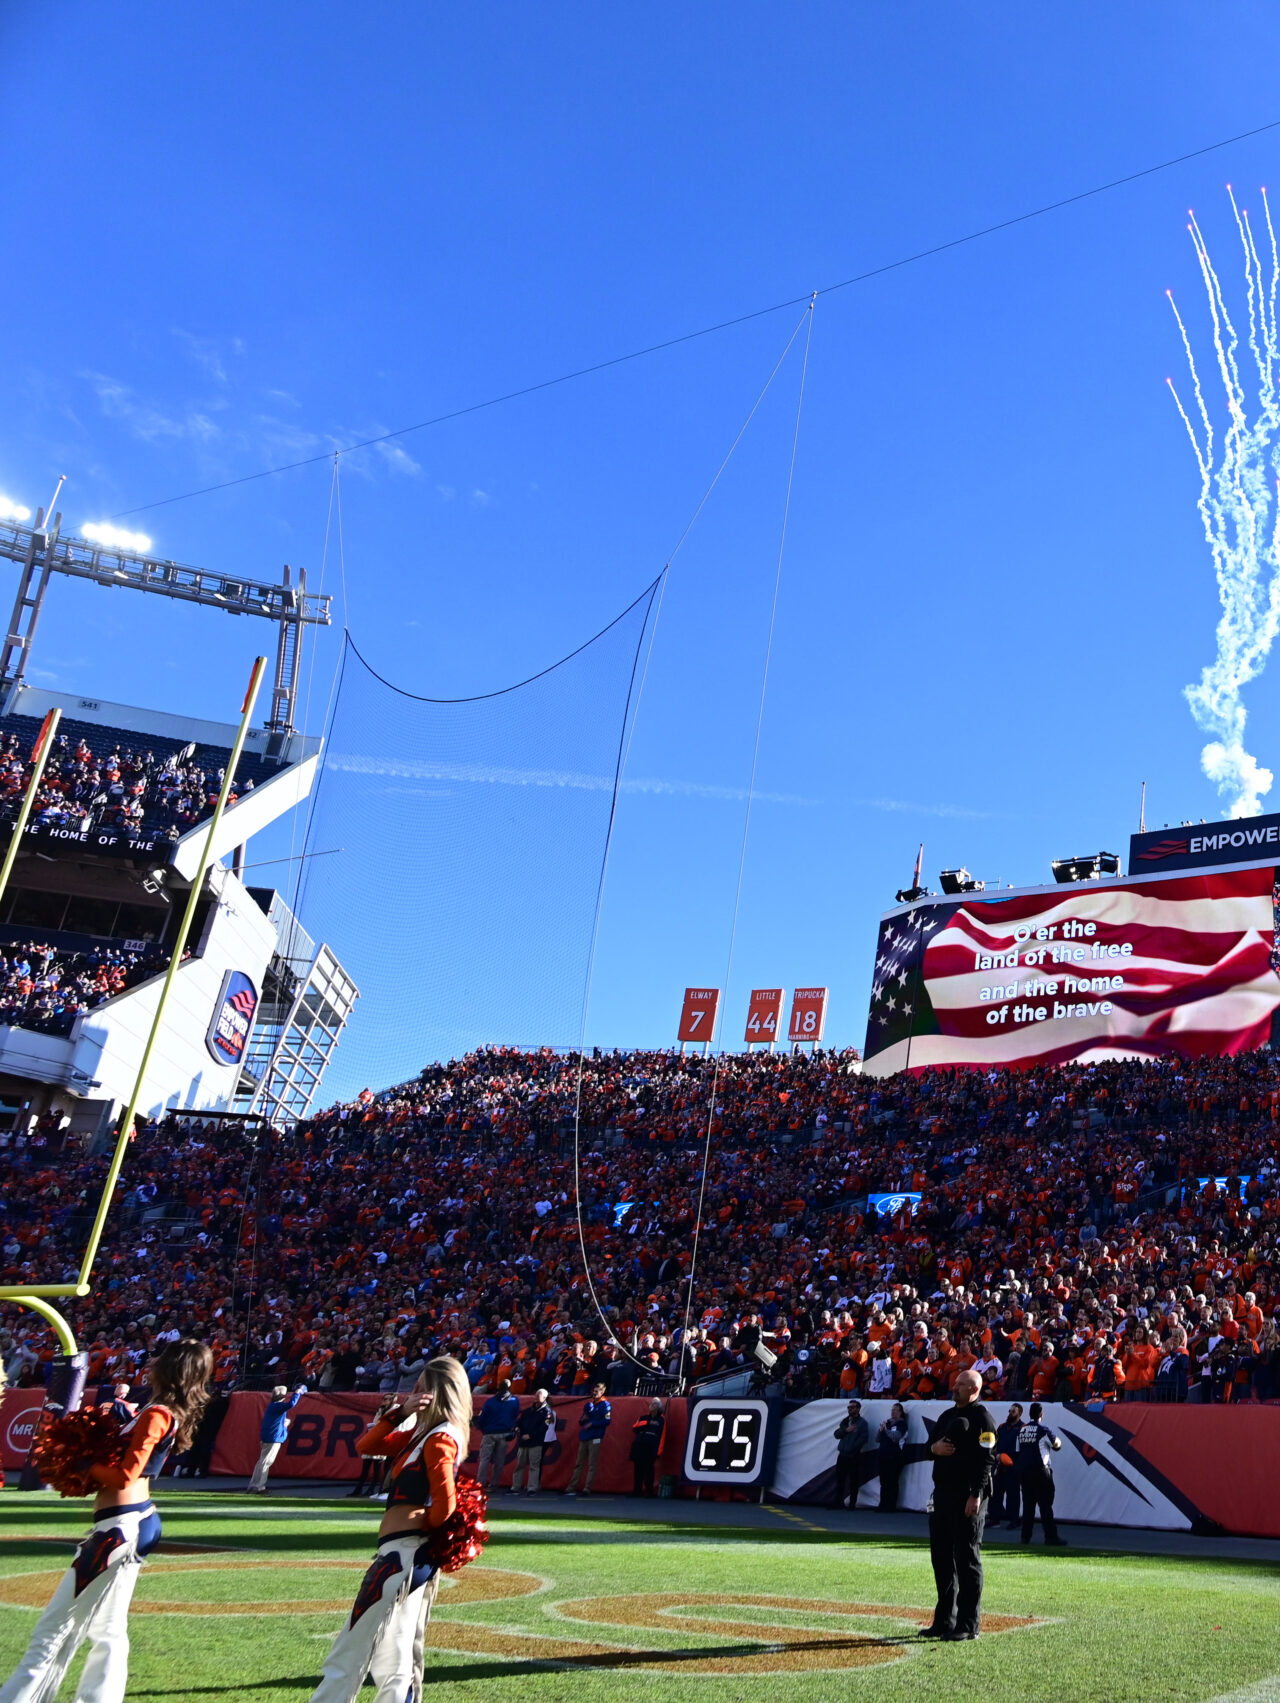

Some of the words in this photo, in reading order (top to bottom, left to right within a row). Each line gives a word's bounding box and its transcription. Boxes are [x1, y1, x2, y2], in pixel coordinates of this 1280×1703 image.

[81, 701, 98, 710] 541
[49, 828, 89, 842] HOME
[98, 835, 118, 846] OF
[128, 839, 155, 851] THE
[1014, 924, 1057, 943] O'er
[1062, 920, 1097, 939] the
[125, 941, 144, 950] 346
[974, 949, 1019, 970] land
[1024, 947, 1047, 966] of
[1050, 945, 1085, 964] the
[1090, 941, 1134, 961] free
[690, 991, 713, 999] ELWAY
[756, 991, 776, 1000] LITTLE
[793, 990, 825, 999] TRIPUCKA
[979, 980, 1019, 1001] and
[1024, 979, 1059, 998] the
[1063, 975, 1124, 995] home
[220, 1000, 249, 1037] EMPOWER
[688, 1011, 706, 1033] 7
[747, 1012, 776, 1034] 44
[794, 1010, 817, 1033] 18
[986, 1005, 1009, 1025] of
[1012, 1003, 1047, 1023] the
[1053, 1000, 1113, 1020] brave
[216, 1015, 234, 1041] FIELD
[699, 1413, 753, 1468] 25
